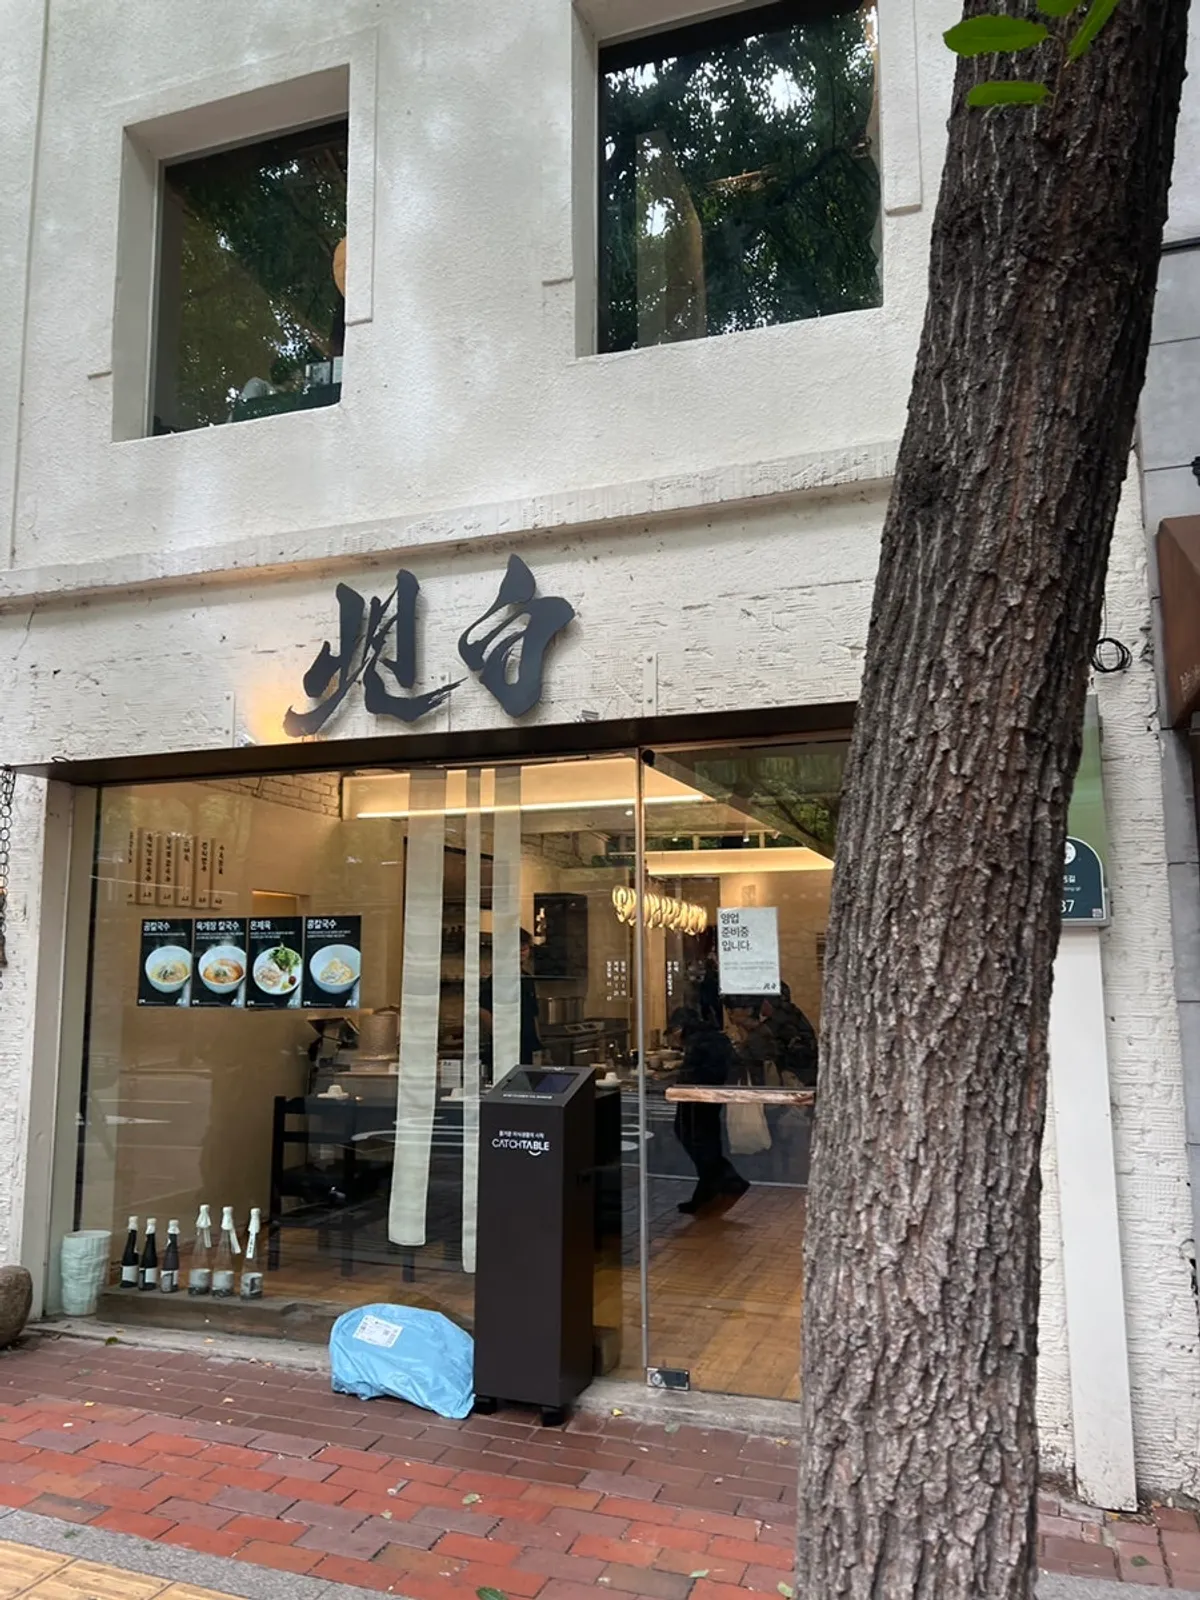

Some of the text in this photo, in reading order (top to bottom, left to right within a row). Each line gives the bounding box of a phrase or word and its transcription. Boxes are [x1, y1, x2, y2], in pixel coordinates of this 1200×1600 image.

[720, 913, 739, 924] 영업
[721, 926, 749, 938] 준비중
[721, 940, 753, 951] 입니다.
[491, 1138, 550, 1151] CATCHTABLE
